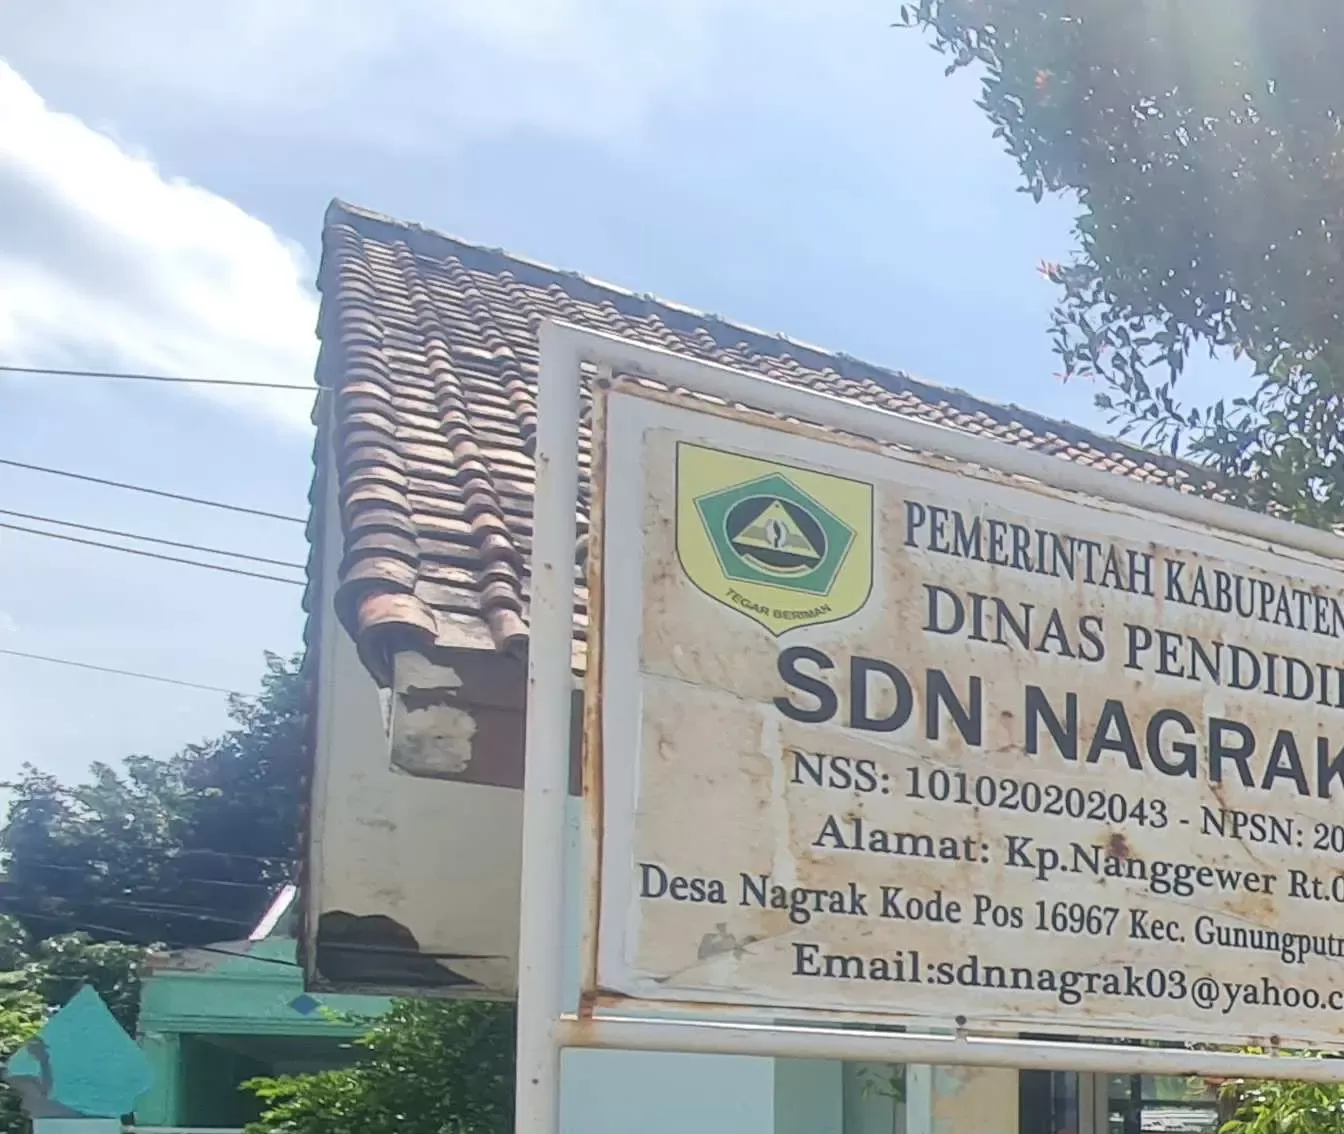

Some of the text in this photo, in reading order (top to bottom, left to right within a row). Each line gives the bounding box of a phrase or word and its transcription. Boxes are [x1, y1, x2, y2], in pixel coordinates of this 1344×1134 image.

[904, 499, 1154, 597] PEMERINTAH
[725, 587, 770, 617] TEGAR
[922, 583, 1106, 663] DINAS
[773, 645, 982, 747] SDN
[789, 750, 891, 794] NSS:
[905, 766, 1169, 829] 101020202043
[1200, 805, 1304, 848] NPSN:
[812, 814, 990, 864] Alamat:
[1003, 835, 1277, 897] Kp.Nanggewer
[639, 862, 727, 905] Desa
[739, 872, 869, 925] Nagrak
[879, 885, 962, 924] Kode
[972, 893, 1024, 929] Pos
[1034, 899, 1120, 937] 16967
[1129, 908, 1186, 943] Kec.
